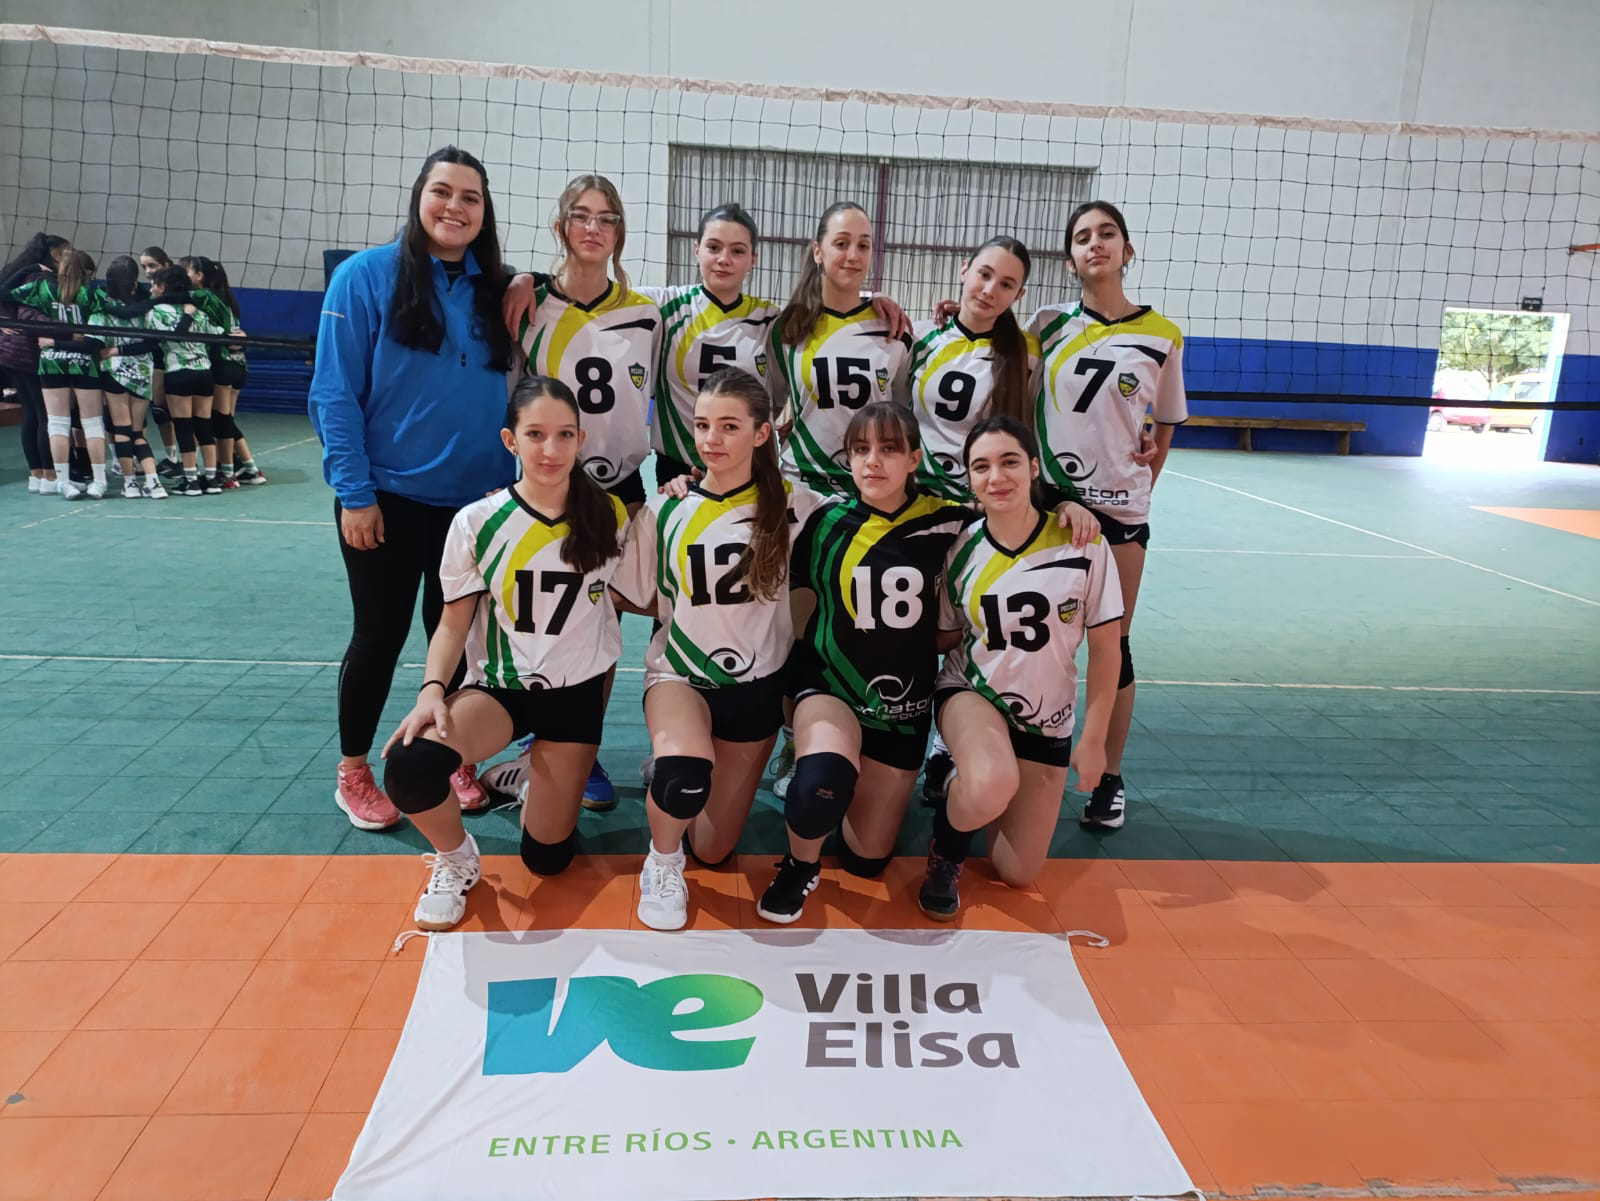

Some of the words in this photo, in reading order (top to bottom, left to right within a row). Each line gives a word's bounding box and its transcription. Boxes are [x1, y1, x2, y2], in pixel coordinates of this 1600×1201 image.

[575, 356, 616, 415] 8
[698, 343, 736, 391] 5
[812, 356, 872, 410] 15
[1073, 357, 1116, 414] 7
[934, 370, 977, 422] 9
[686, 542, 756, 607] 12
[851, 565, 925, 630] 18
[514, 569, 585, 636] 17
[980, 591, 1051, 653] 13
[795, 972, 982, 1014] Villa
[804, 1020, 1020, 1068] Elisa
[488, 1134, 611, 1157] ENTRE
[625, 1128, 712, 1152] RÍOS
[752, 1129, 963, 1150] ARGENTINA
